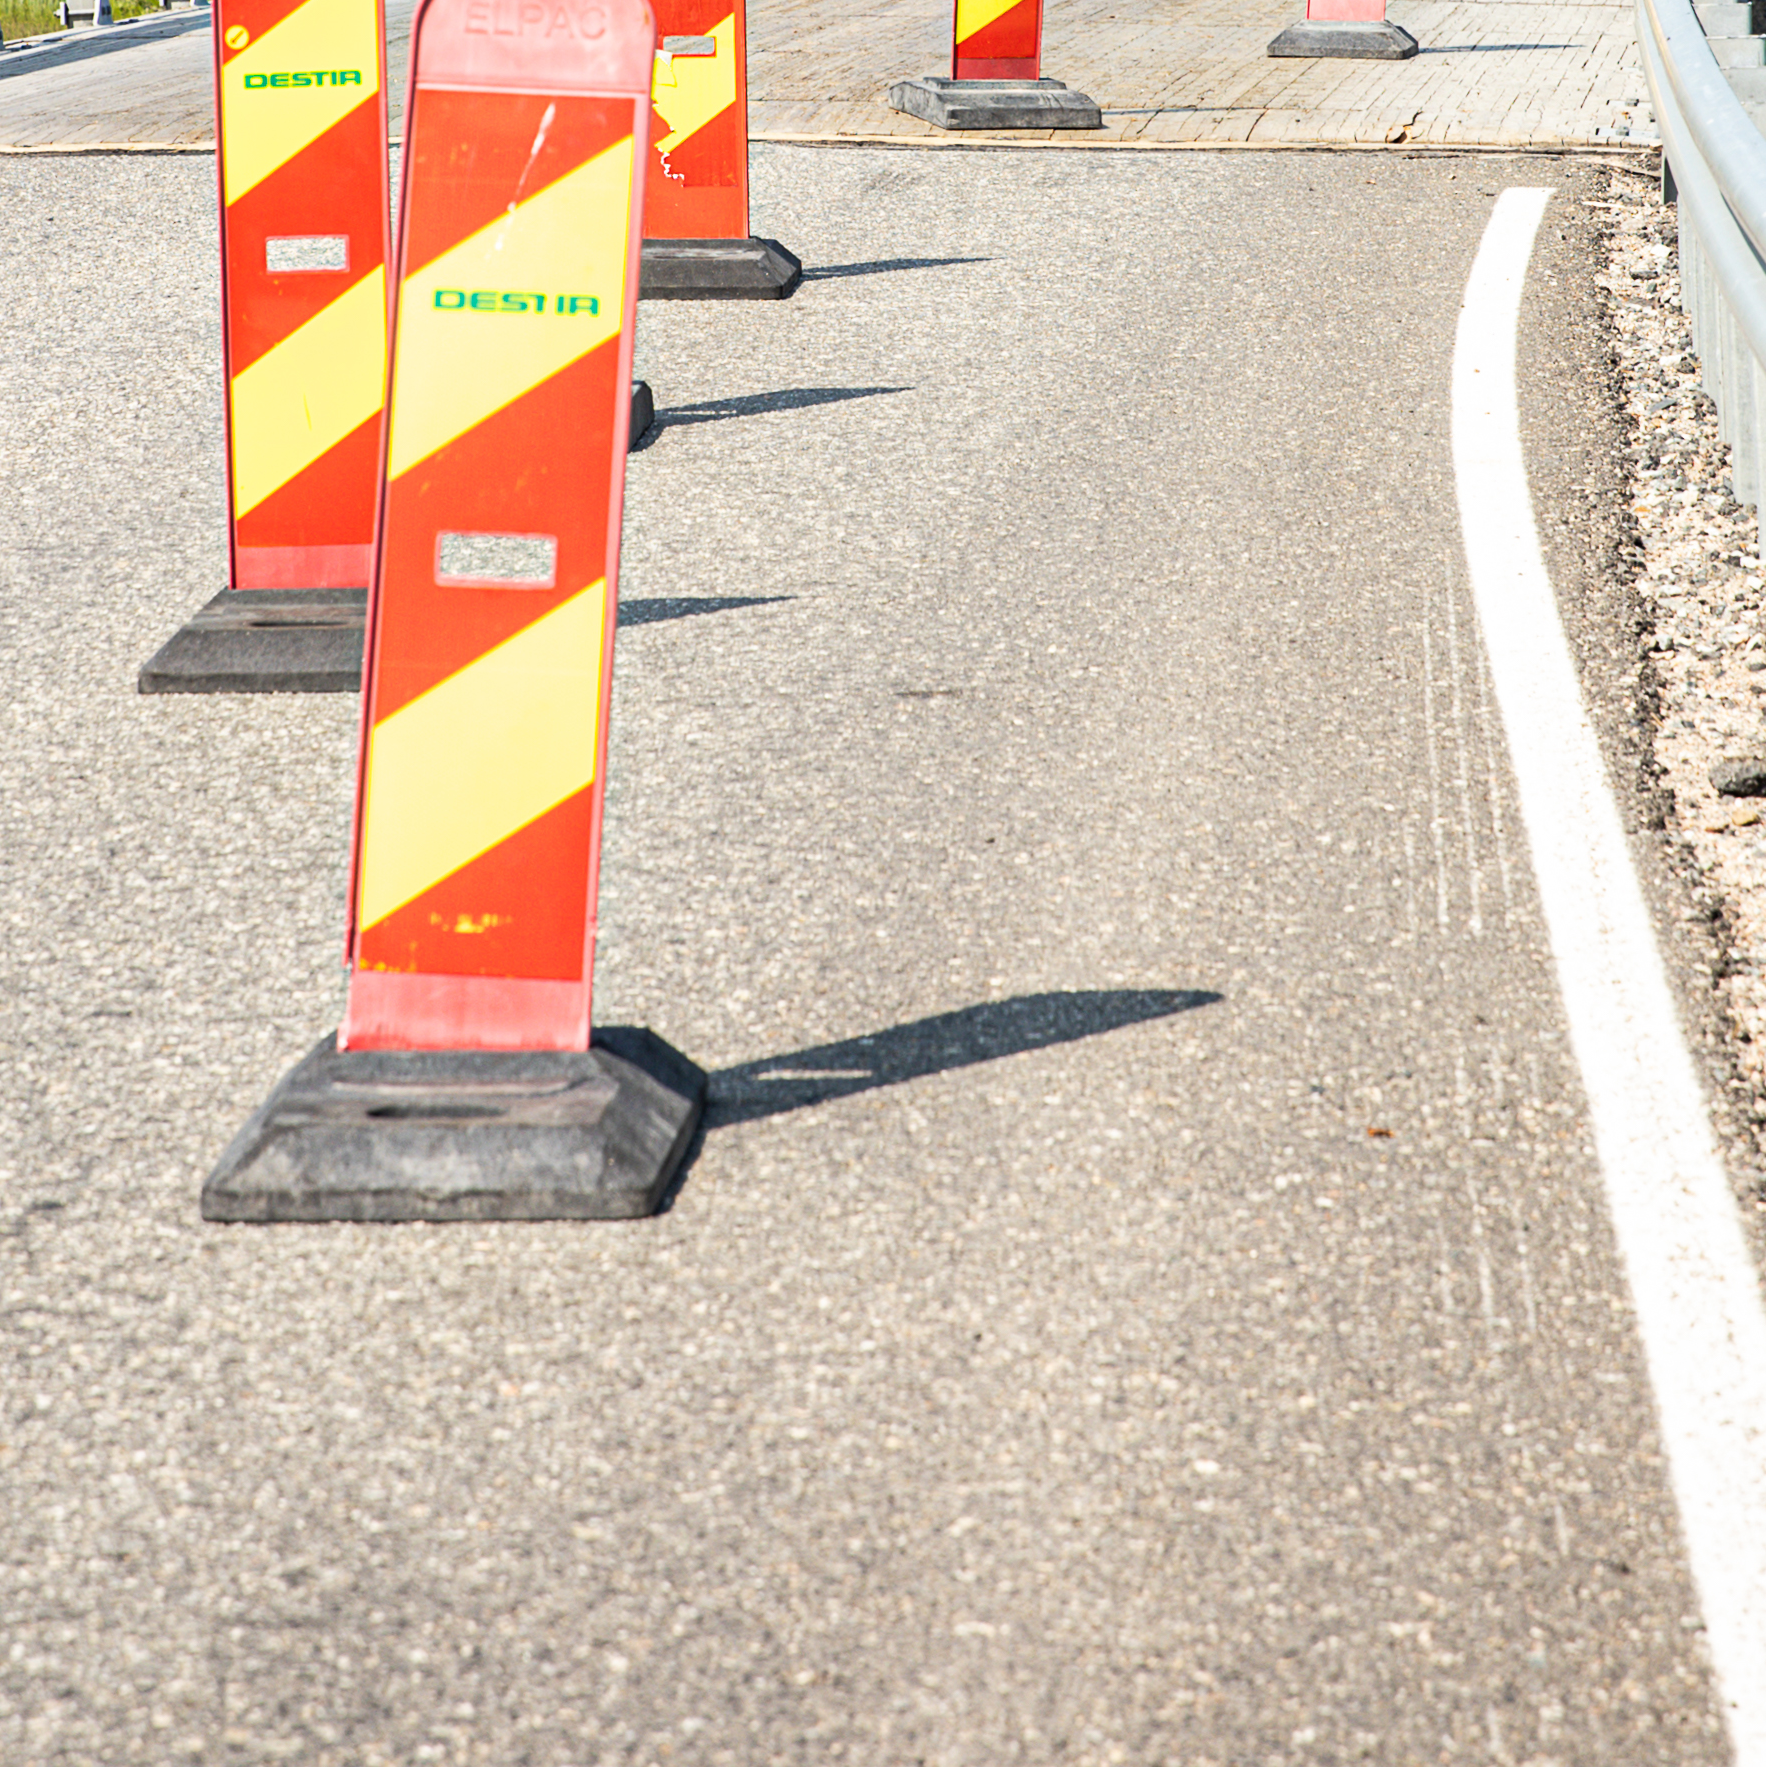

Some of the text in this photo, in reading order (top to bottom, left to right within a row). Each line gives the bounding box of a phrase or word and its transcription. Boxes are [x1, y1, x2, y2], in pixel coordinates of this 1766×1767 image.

[464, 1, 607, 40] ELPAC
[244, 70, 361, 89] DESTIA
[434, 289, 600, 316] DESTIA
